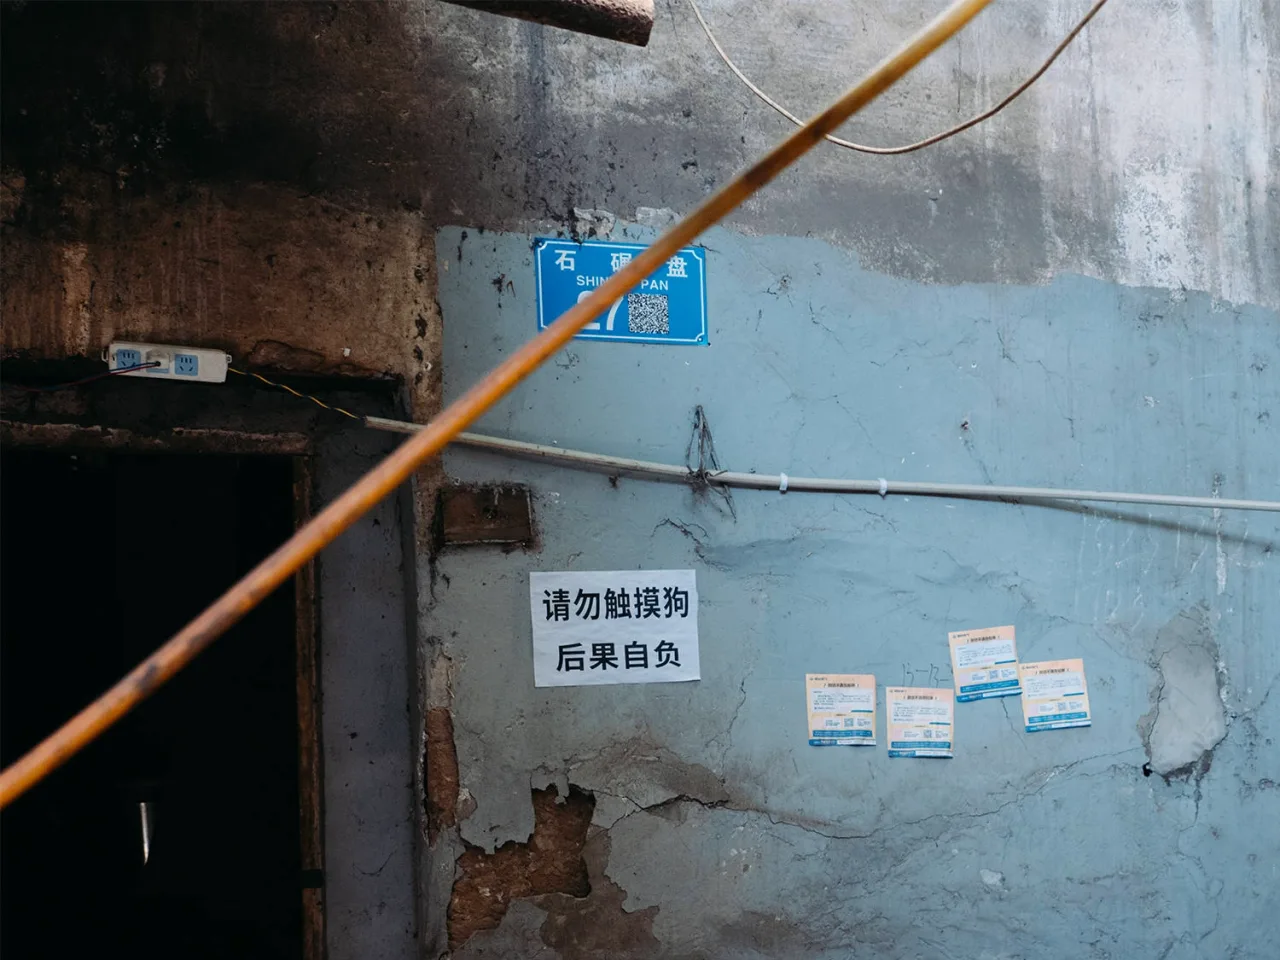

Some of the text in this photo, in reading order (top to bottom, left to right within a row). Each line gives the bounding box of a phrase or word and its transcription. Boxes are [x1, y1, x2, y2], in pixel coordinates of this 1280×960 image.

[640, 279, 669, 291] PAN
[542, 586, 689, 622] 请勿触摸狗
[556, 640, 682, 672] 后果自负
